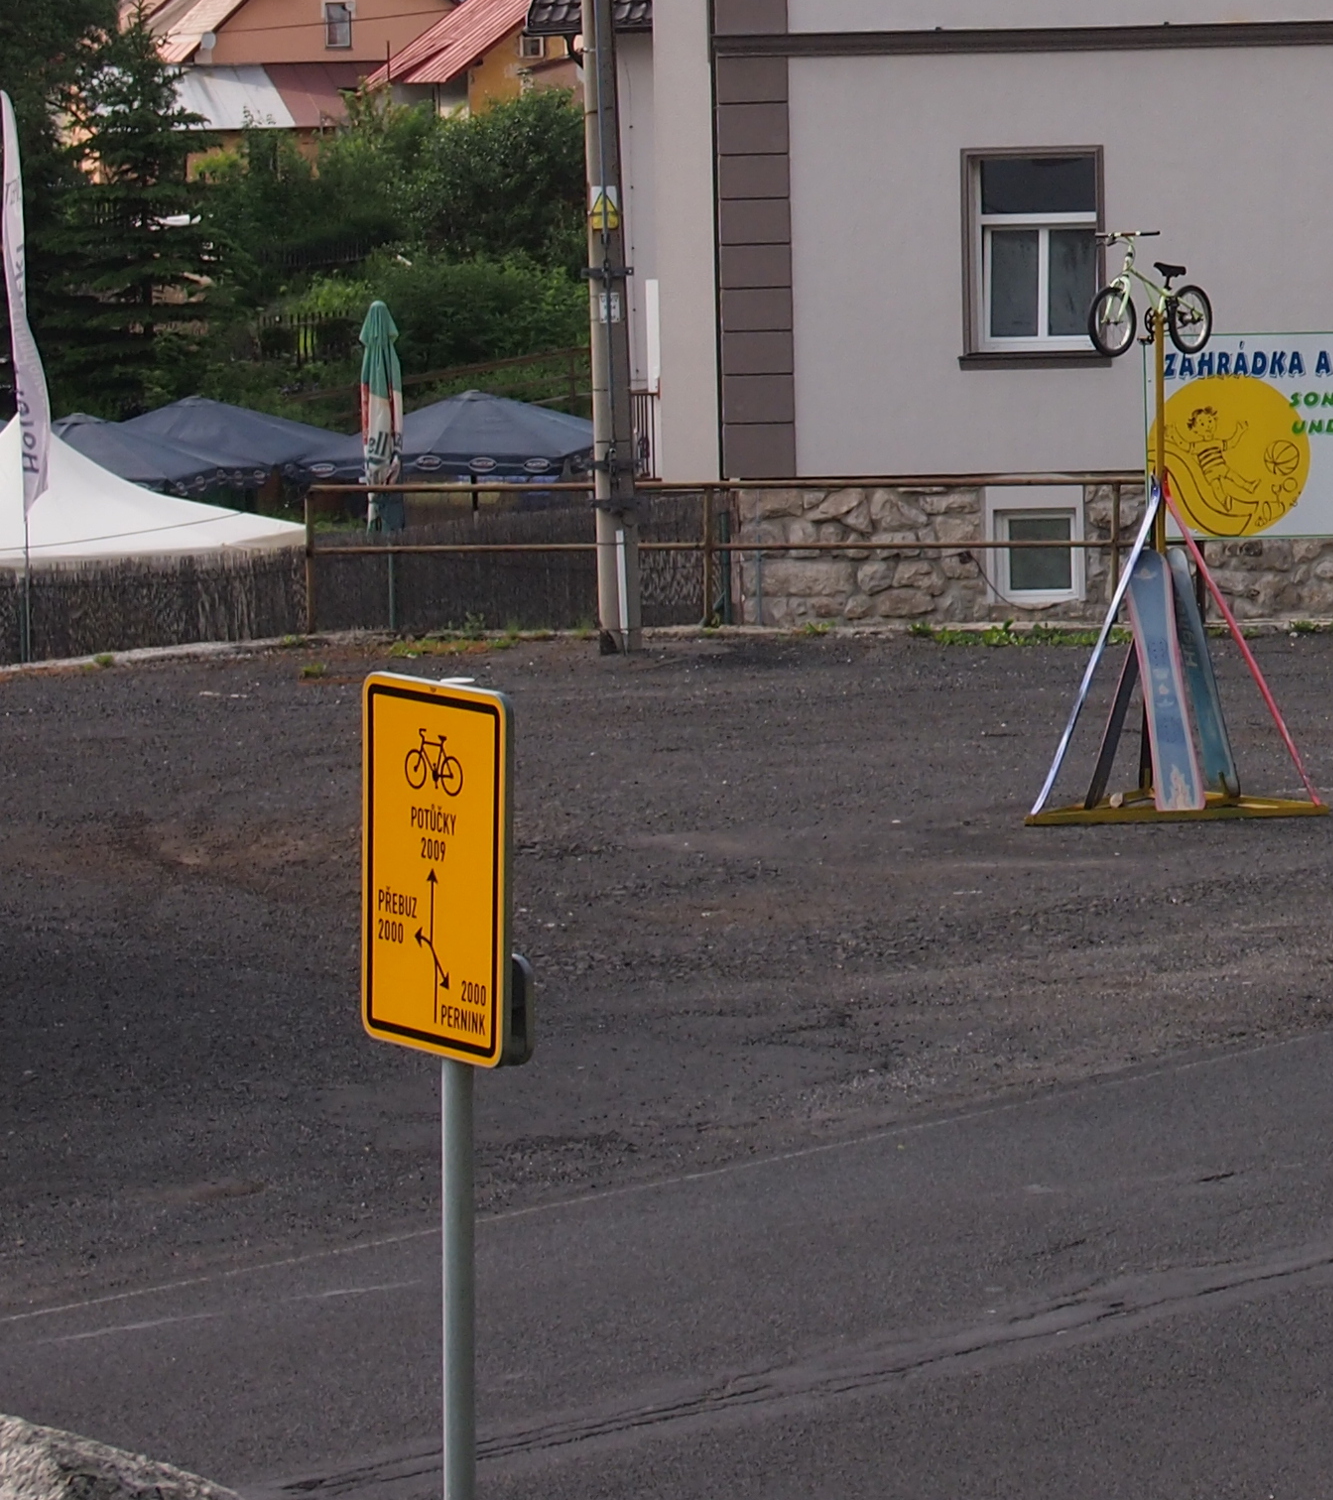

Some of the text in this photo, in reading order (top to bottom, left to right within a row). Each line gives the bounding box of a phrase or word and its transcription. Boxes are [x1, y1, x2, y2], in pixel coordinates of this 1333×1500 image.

[1163, 341, 1305, 380] ZAHRÁDKA
[1316, 350, 1333, 377] A
[411, 803, 456, 836] POTŮČKY
[420, 837, 446, 862] 2009
[378, 886, 418, 920] PŘEBUZ
[378, 919, 404, 944] 2000
[461, 980, 486, 1007] 2000
[441, 1004, 486, 1037] PERNINK
